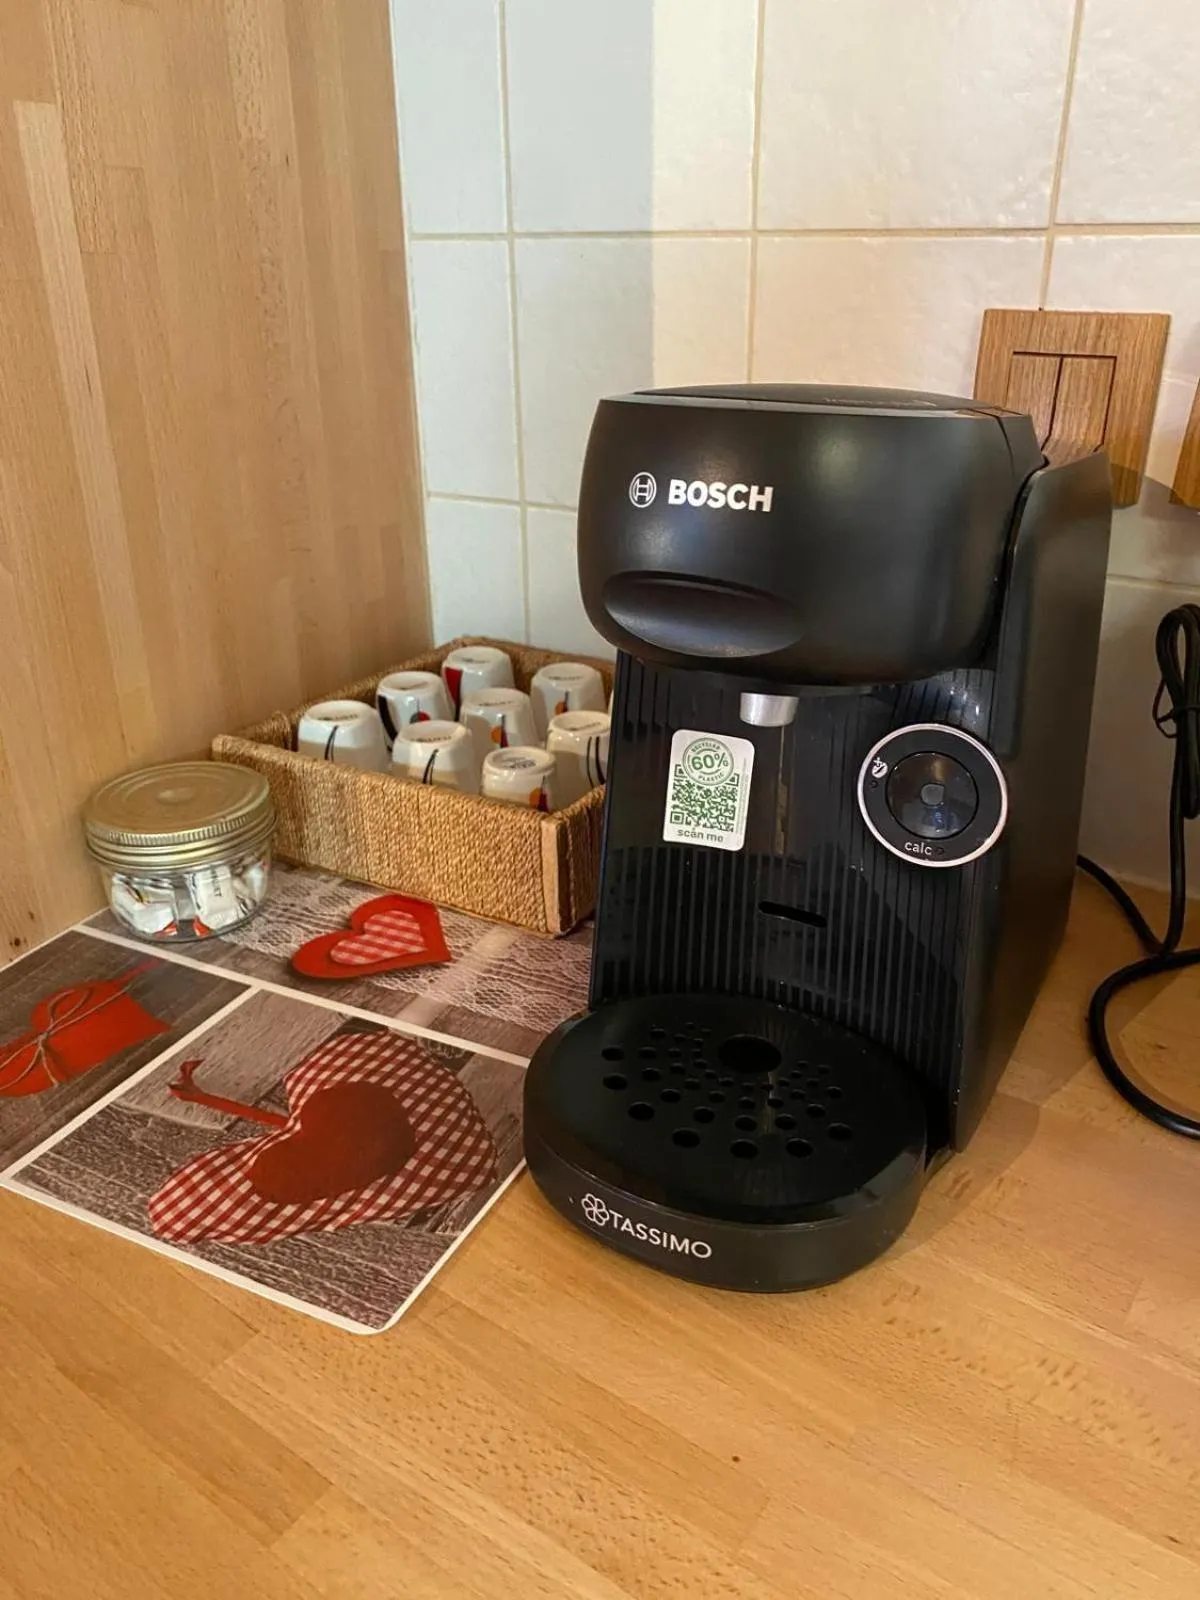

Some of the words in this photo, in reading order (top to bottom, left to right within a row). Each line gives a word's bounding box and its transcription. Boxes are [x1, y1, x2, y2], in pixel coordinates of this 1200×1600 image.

[668, 479, 774, 512] BOSCH
[691, 752, 729, 771] 60%
[698, 772, 725, 782] PLASTIC
[677, 829, 704, 840] scan
[706, 833, 724, 843] me
[904, 841, 933, 856] calc
[609, 1209, 712, 1258] TASSIMO
